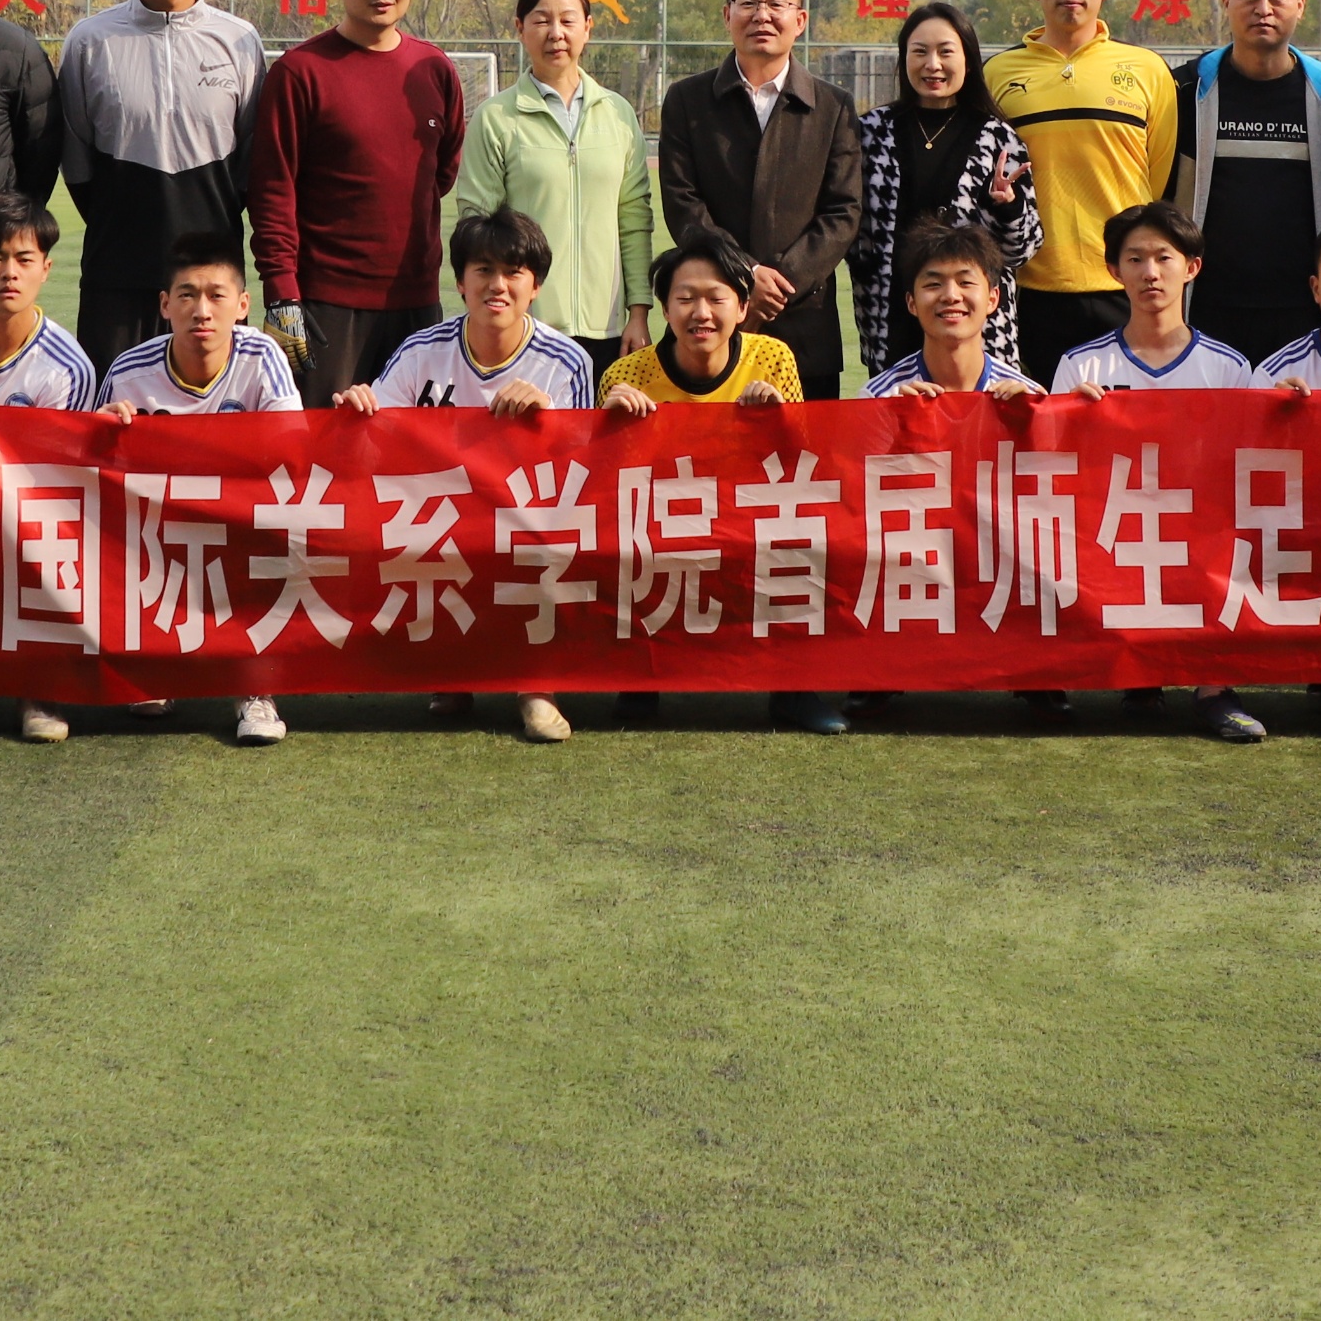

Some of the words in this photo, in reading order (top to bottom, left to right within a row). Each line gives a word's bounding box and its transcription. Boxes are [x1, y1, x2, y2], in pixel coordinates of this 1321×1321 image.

[197, 76, 236, 89] NIKE
[1113, 72, 1134, 87] BVB
[1281, 123, 1307, 134] ITAL
